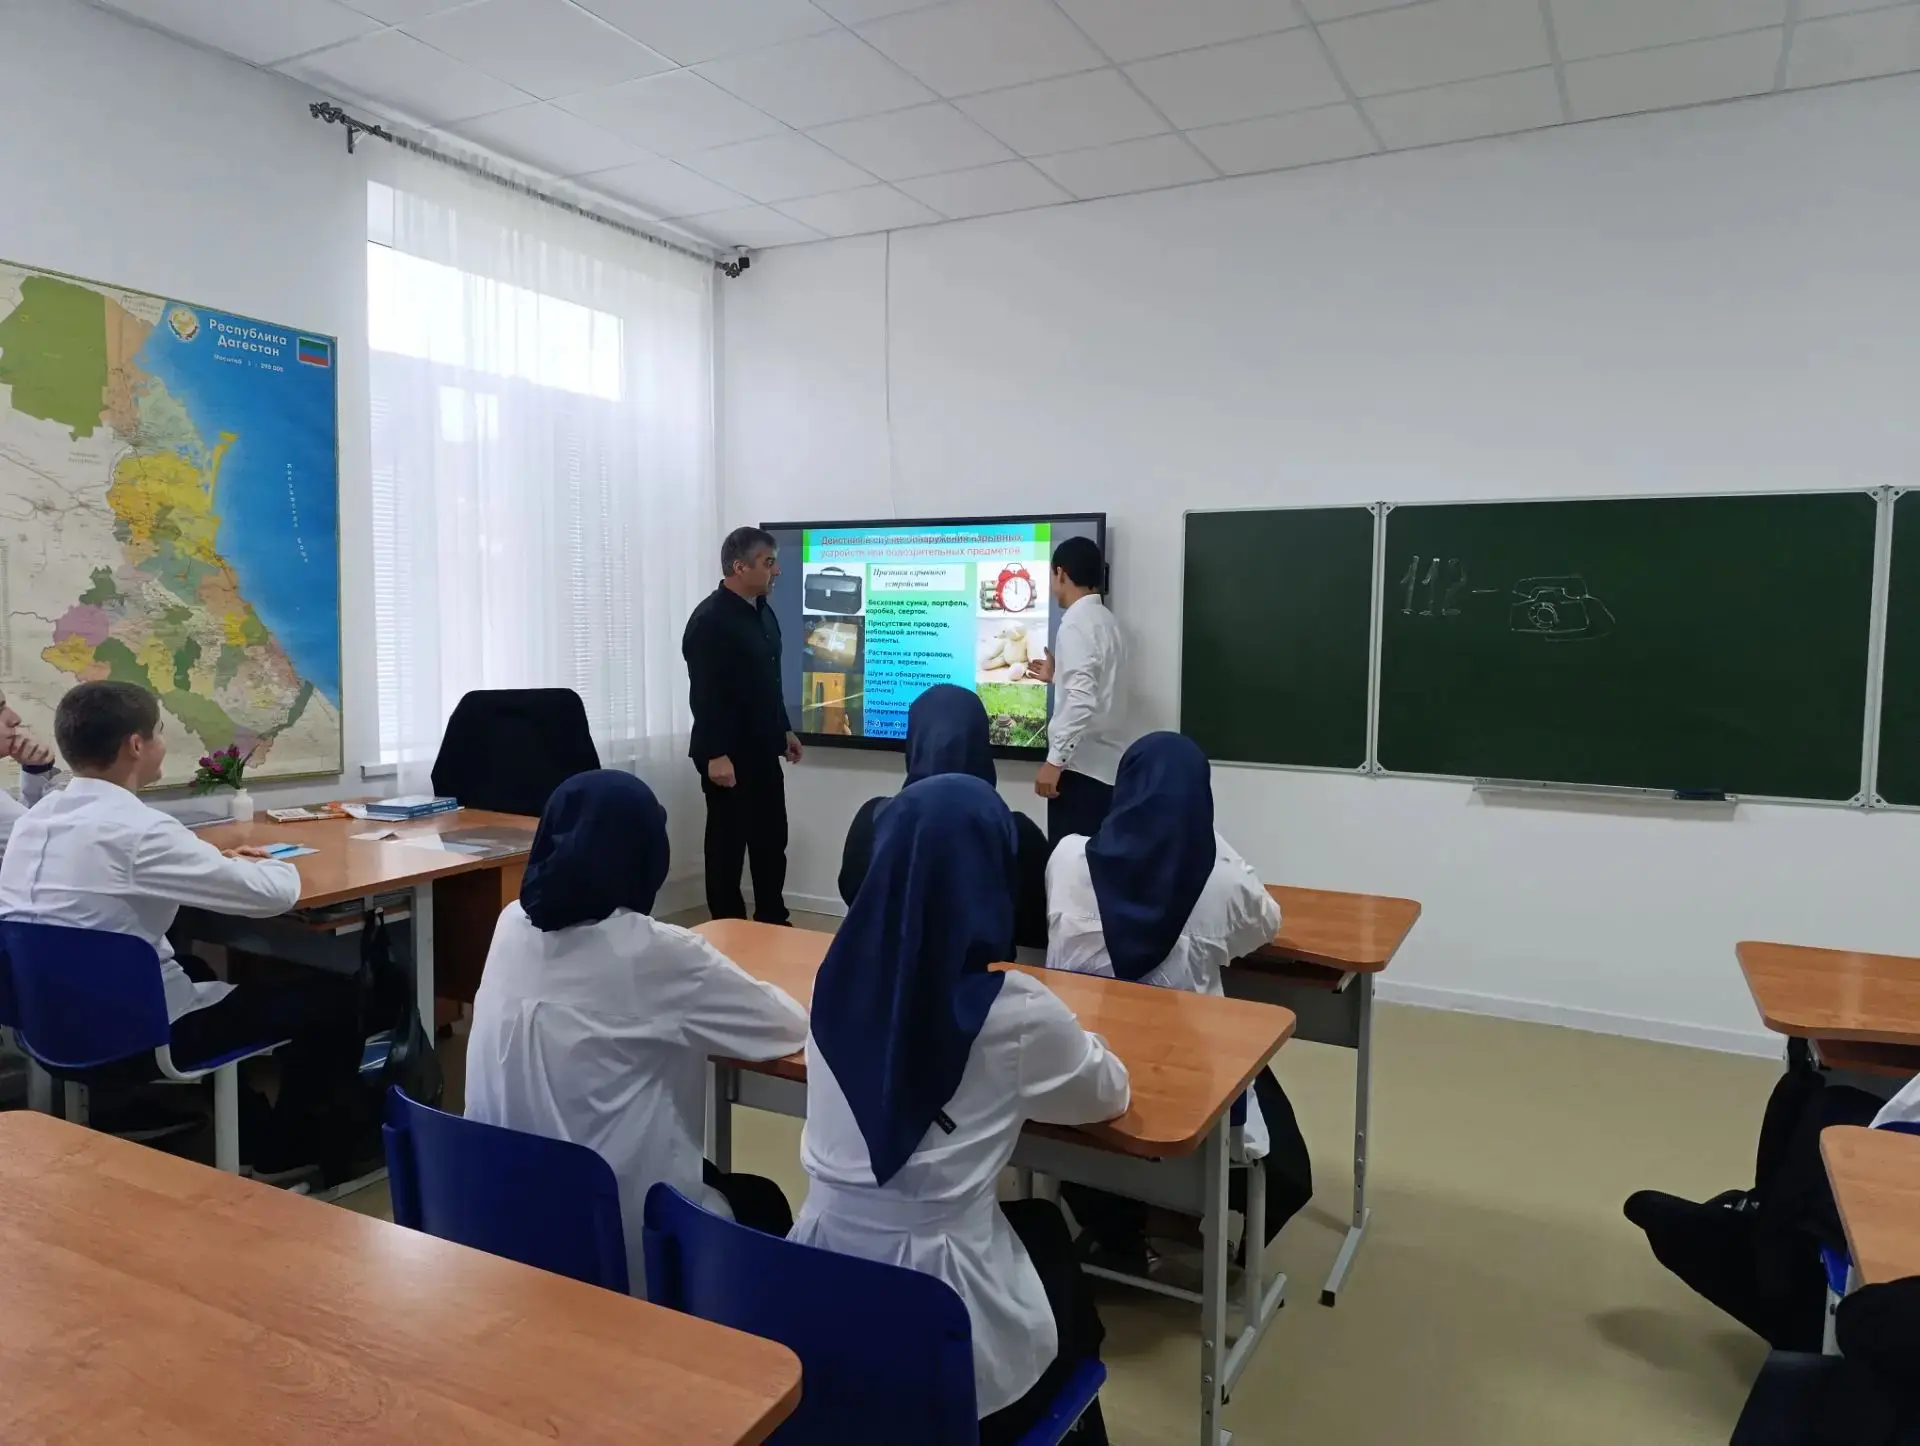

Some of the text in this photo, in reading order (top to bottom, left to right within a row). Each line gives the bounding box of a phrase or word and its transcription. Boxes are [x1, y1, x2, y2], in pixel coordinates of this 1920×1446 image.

[208, 318, 288, 346] Республика
[217, 335, 280, 357] Дагестан
[967, 546, 1021, 557] предметов
[1400, 555, 1468, 616] 112
[895, 670, 952, 680] обнаруженного
